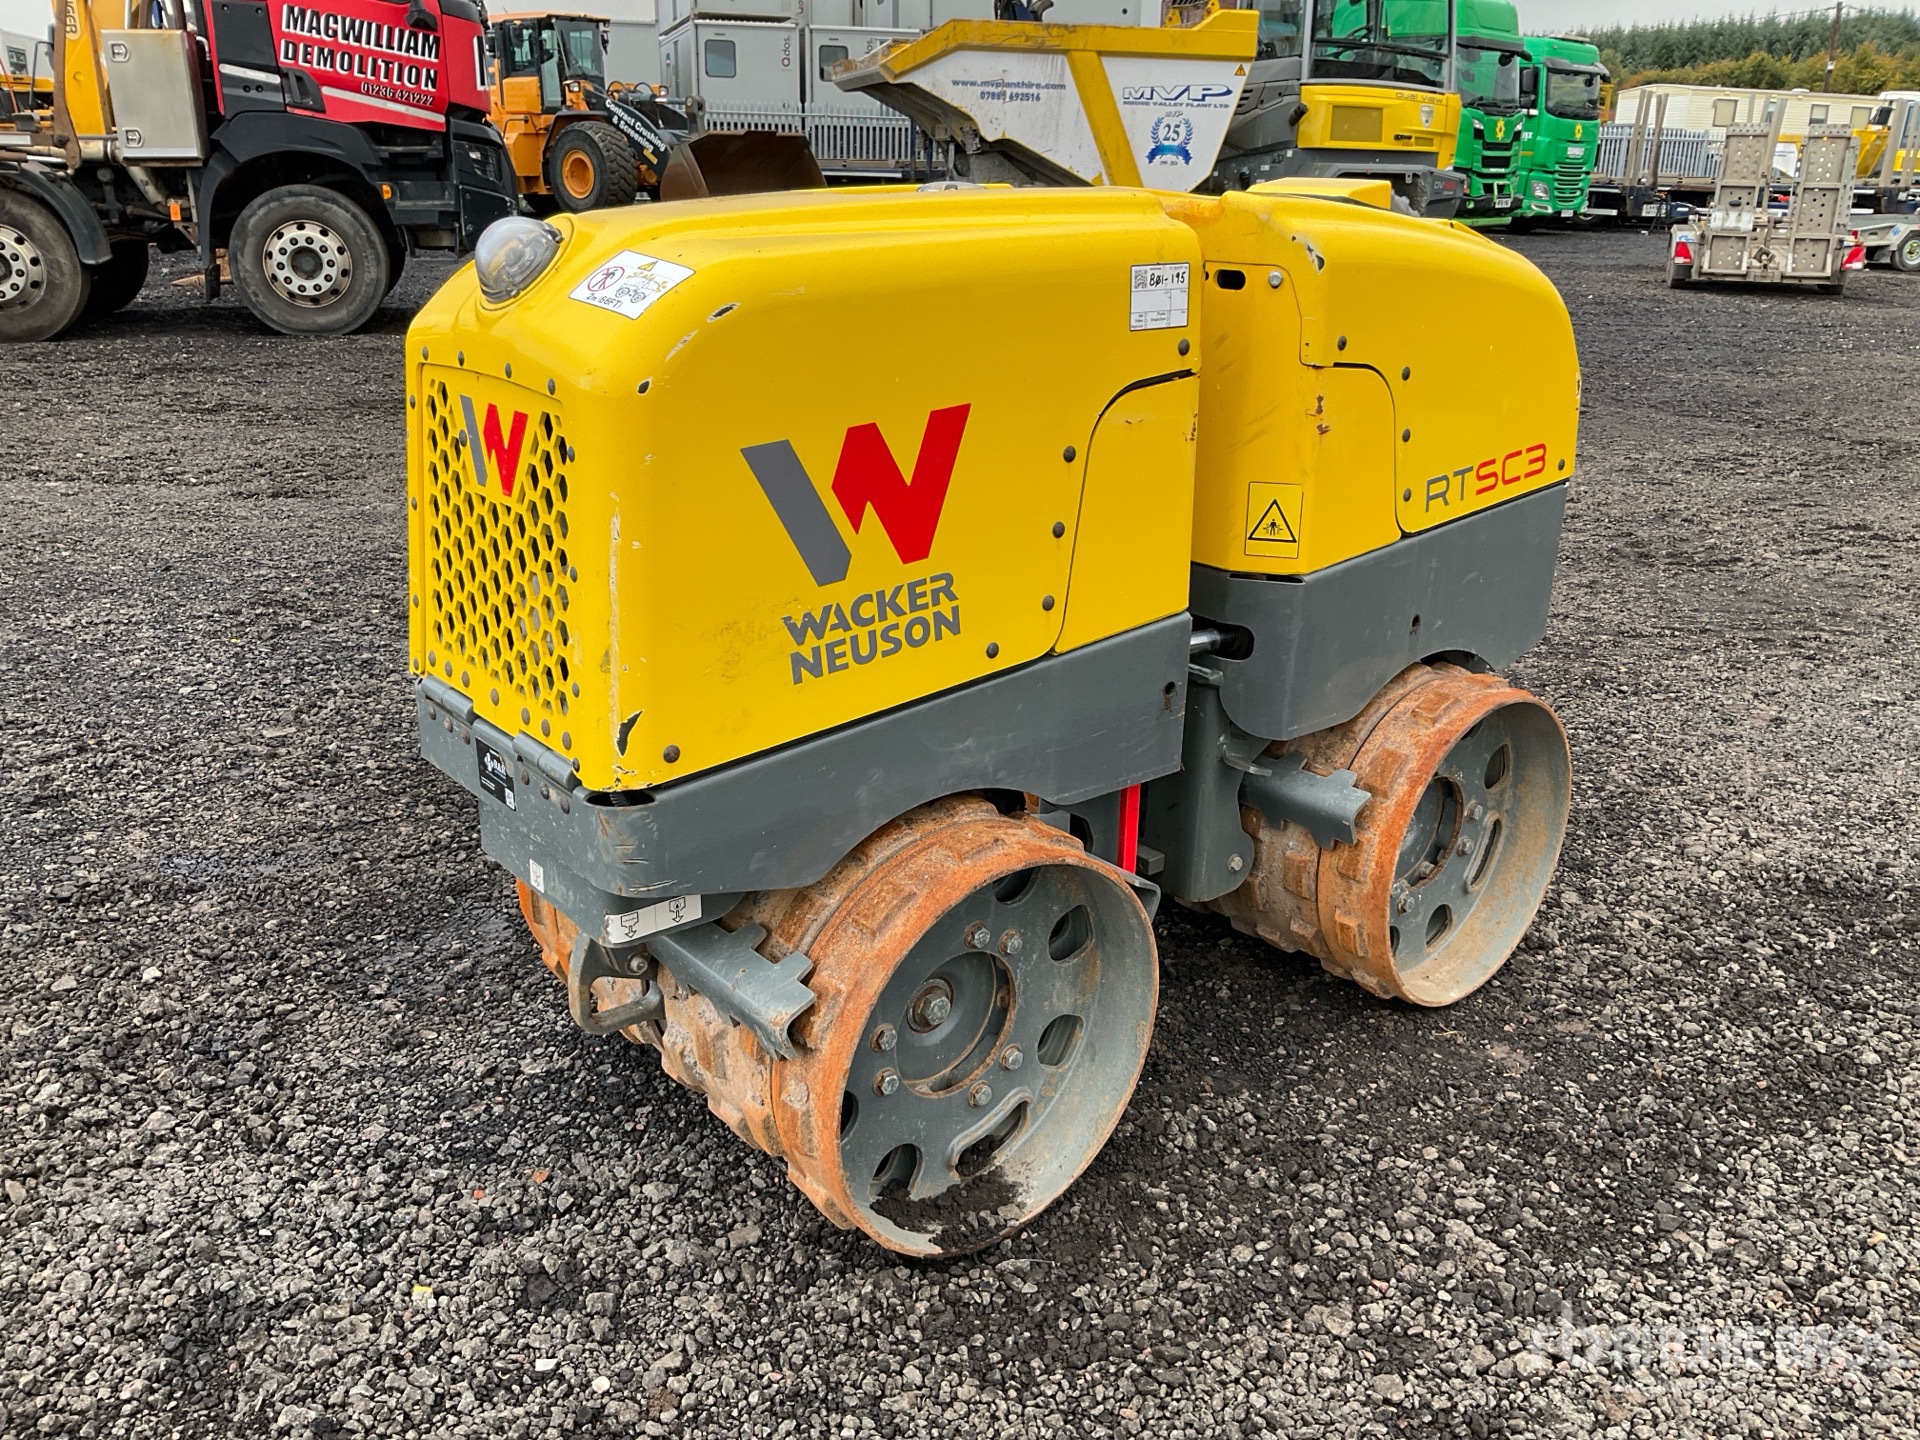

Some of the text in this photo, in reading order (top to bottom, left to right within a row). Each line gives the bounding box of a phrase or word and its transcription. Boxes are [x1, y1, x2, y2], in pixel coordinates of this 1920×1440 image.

[282, 4, 441, 62] MACWILLIAM
[280, 39, 438, 92] DEMOLITION
[951, 79, 1066, 90] www.mvplanthire.com
[361, 82, 434, 107] 01236 421222
[1009, 92, 1041, 102] 692516
[1122, 84, 1233, 102] MVP
[1153, 100, 1184, 108] VALLEY
[1185, 101, 1213, 109] PLANT
[605, 99, 666, 152] Contract Crushing
[612, 115, 655, 152] & Screening
[1425, 443, 1547, 513] RTSC3
[781, 572, 959, 646] WACKER
[790, 605, 961, 685] NEUSON
